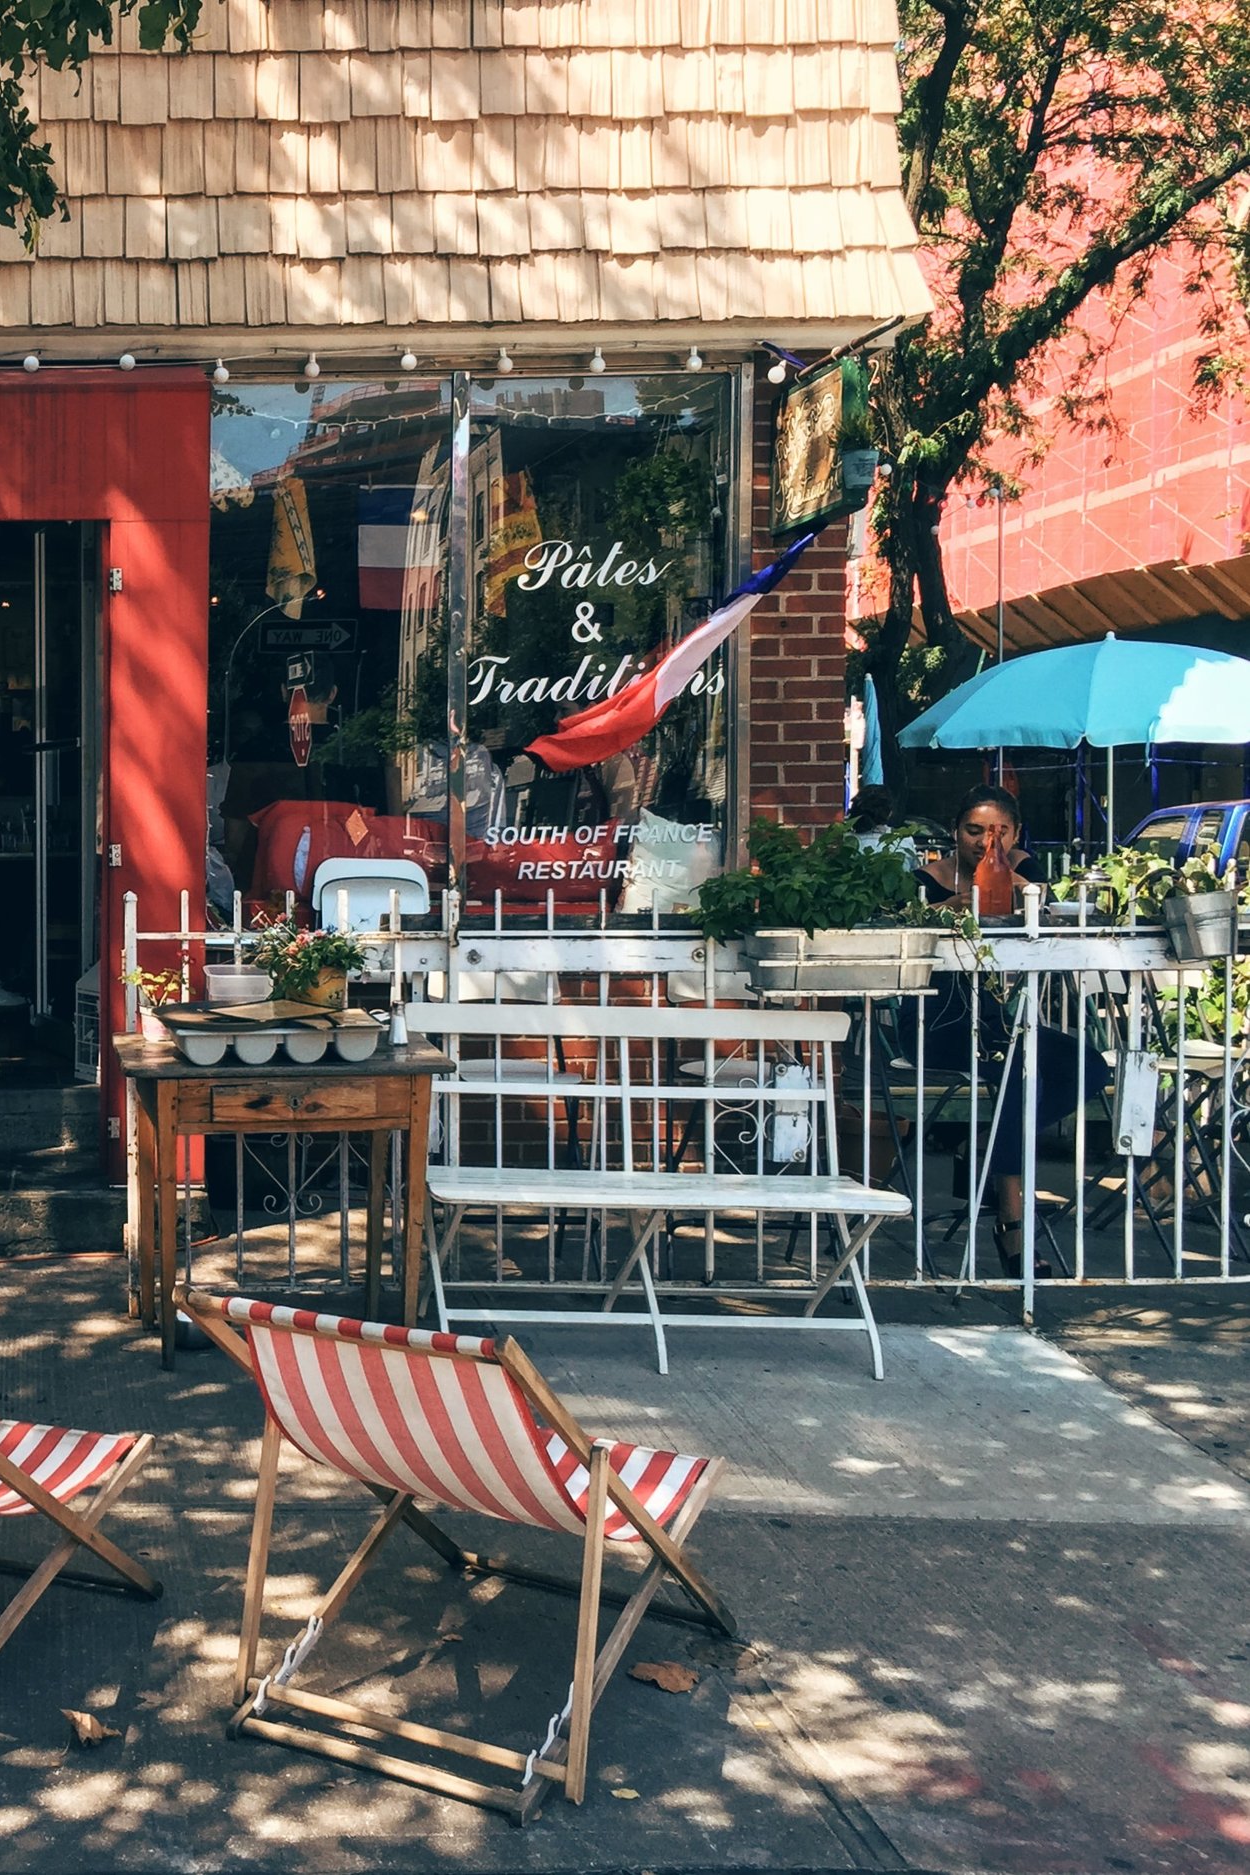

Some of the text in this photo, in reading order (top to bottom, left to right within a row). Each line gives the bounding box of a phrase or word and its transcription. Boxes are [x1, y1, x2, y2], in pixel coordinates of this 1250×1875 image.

[517, 540, 673, 591] Pâtes
[571, 601, 603, 643] &
[467, 654, 725, 706] Traditins
[484, 823, 714, 846] SOUTH OF FRANCE
[517, 860, 680, 880] RESTAURANT
